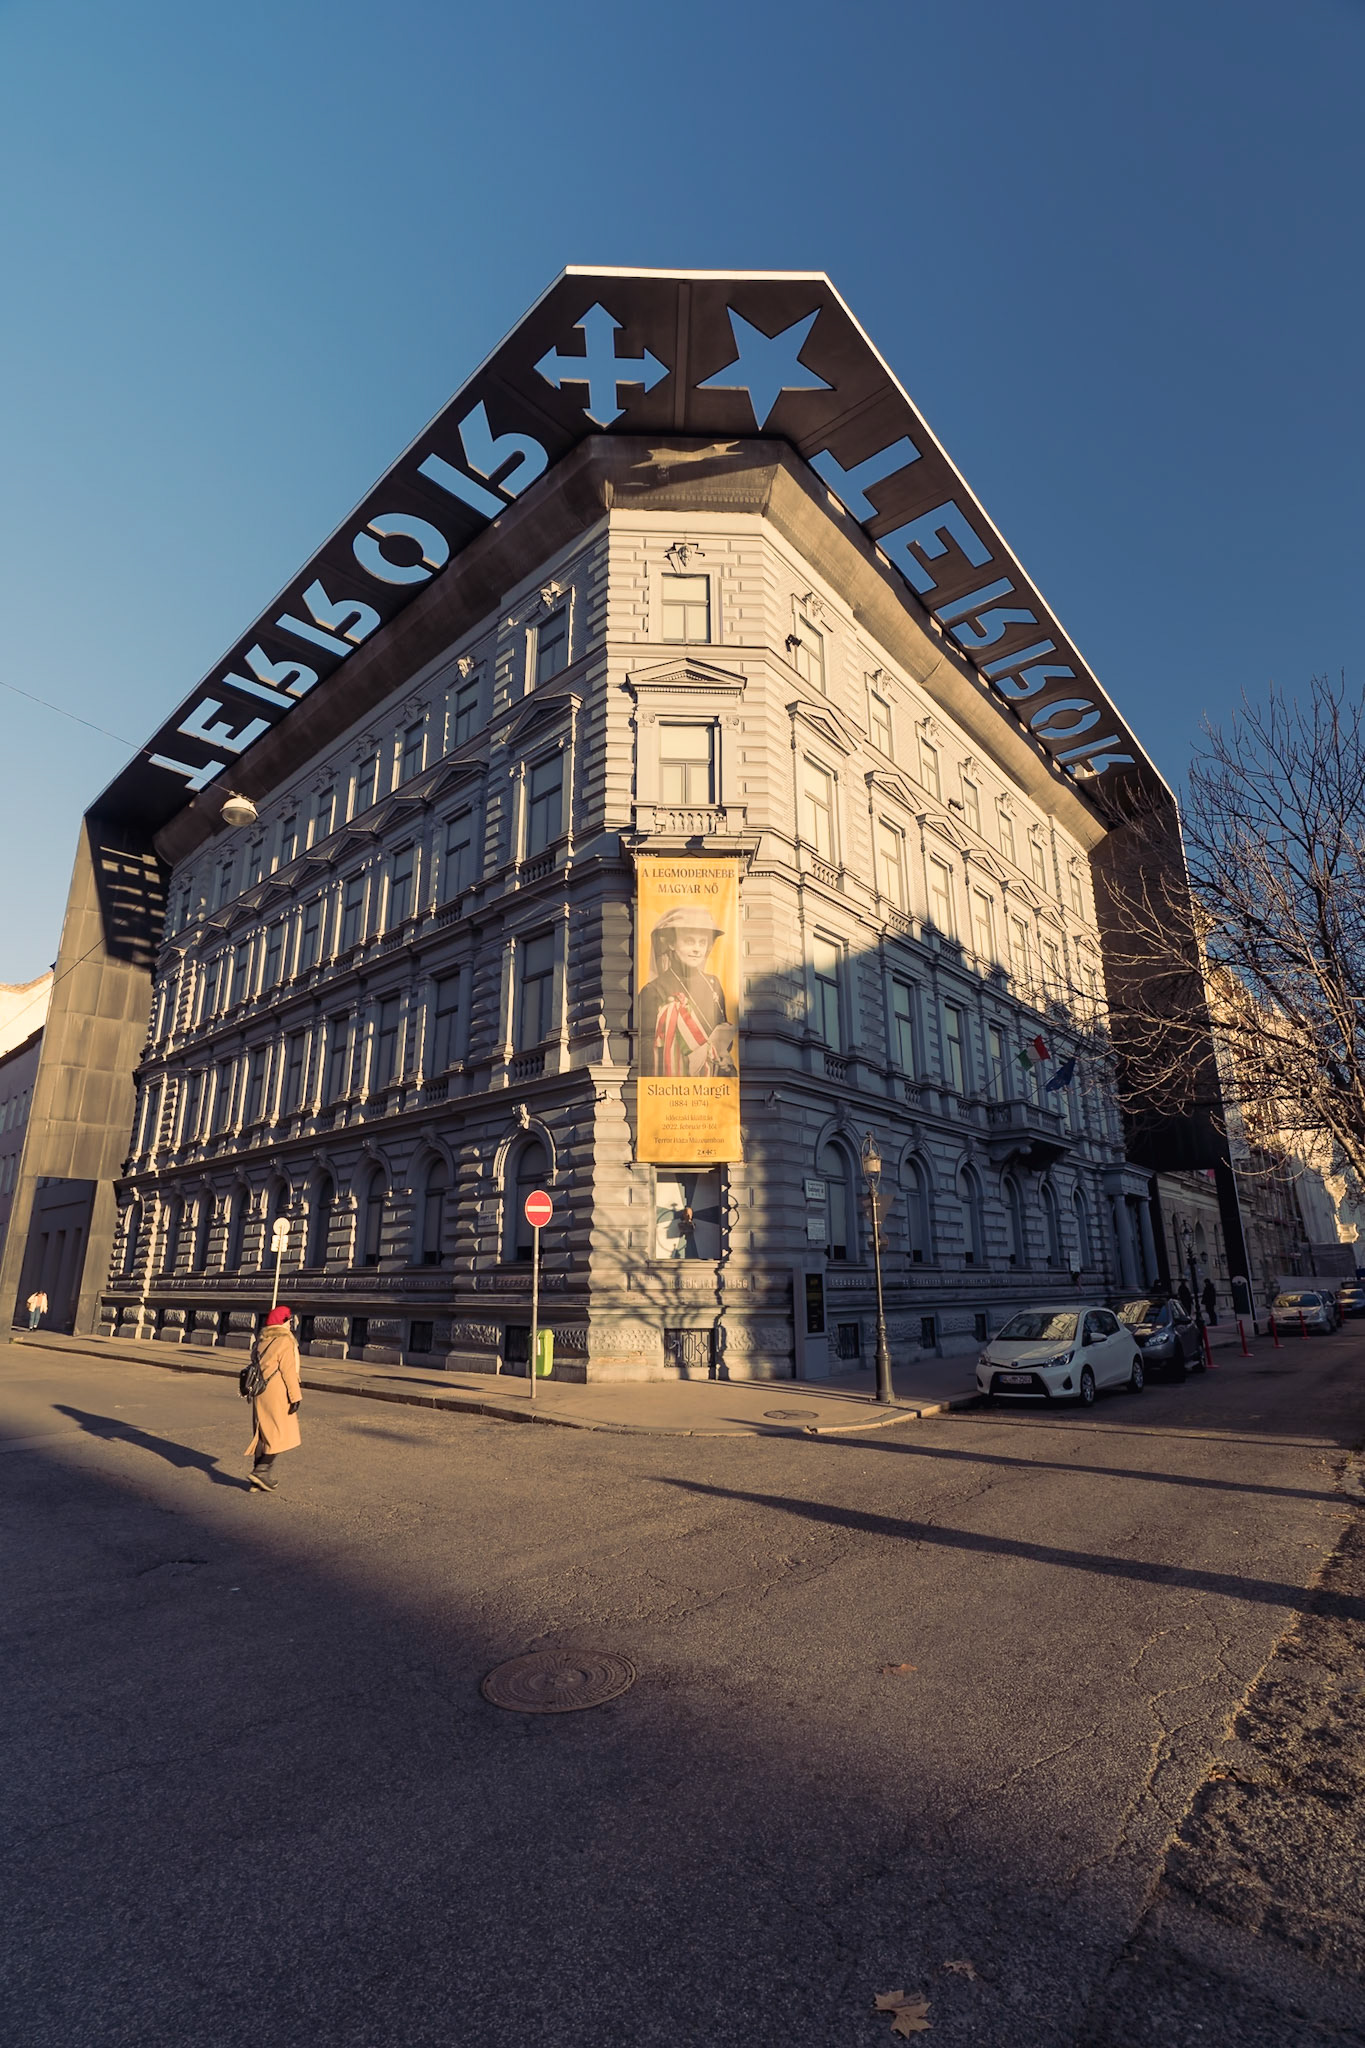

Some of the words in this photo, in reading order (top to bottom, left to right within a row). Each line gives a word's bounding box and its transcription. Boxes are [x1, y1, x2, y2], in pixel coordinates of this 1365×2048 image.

[641, 869, 649, 878] A
[652, 868, 735, 878] LEGMODERNEBB
[658, 884, 701, 894] MAGYAR
[704, 882, 719, 894] NŐ
[647, 1084, 690, 1096] Slachta
[693, 1083, 730, 1099] Margit
[669, 1099, 709, 1108] (18841974)
